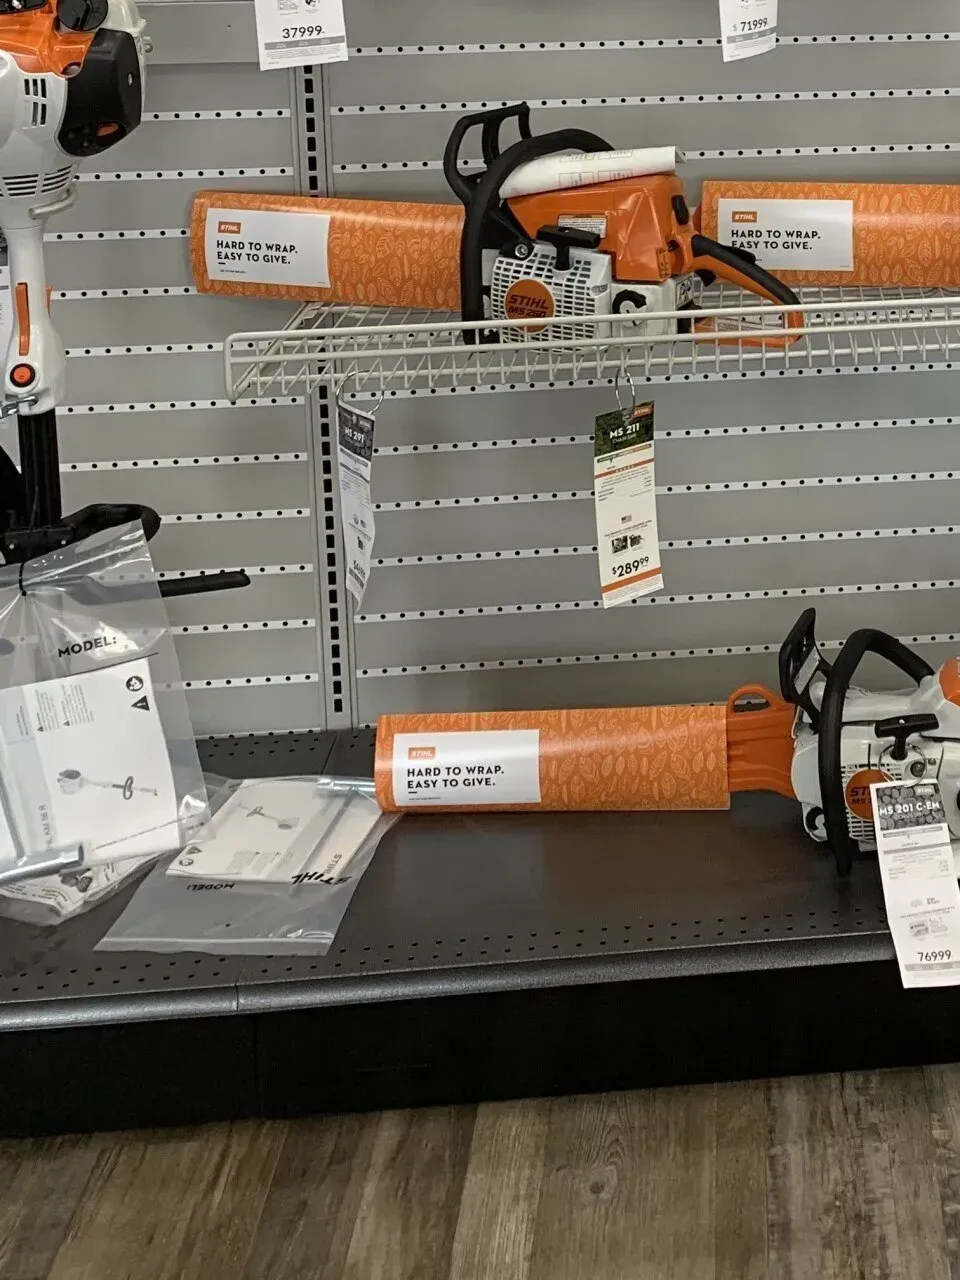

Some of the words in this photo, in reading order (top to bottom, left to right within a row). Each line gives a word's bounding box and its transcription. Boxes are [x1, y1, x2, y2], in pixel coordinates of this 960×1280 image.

[731, 230, 762, 239] HARD
[766, 230, 781, 239] TO
[785, 230, 821, 239] WRAP.
[216, 240, 245, 250] HARD
[248, 242, 261, 251] TO
[265, 243, 298, 254] WRAP.
[731, 240, 759, 249] EASY
[764, 241, 778, 249] TO
[782, 241, 812, 250] GIVE.
[217, 251, 242, 261] EASY
[245, 253, 259, 262] TO
[263, 254, 291, 264] GIVE.
[508, 294, 549, 310] STIHL
[609, 428, 623, 440] MS
[626, 423, 640, 434] 211
[57, 636, 117, 658] MODEL:
[407, 767, 441, 777] HARD
[445, 766, 461, 776] TO
[466, 765, 504, 775] WRAP.
[407, 780, 438, 789] EASY
[442, 779, 458, 787] TO
[463, 778, 496, 787] GIVE.
[880, 807, 893, 816] MS
[895, 803, 914, 813] 201
[291, 871, 351, 886] STIHL
[187, 883, 235, 892] MODEL:
